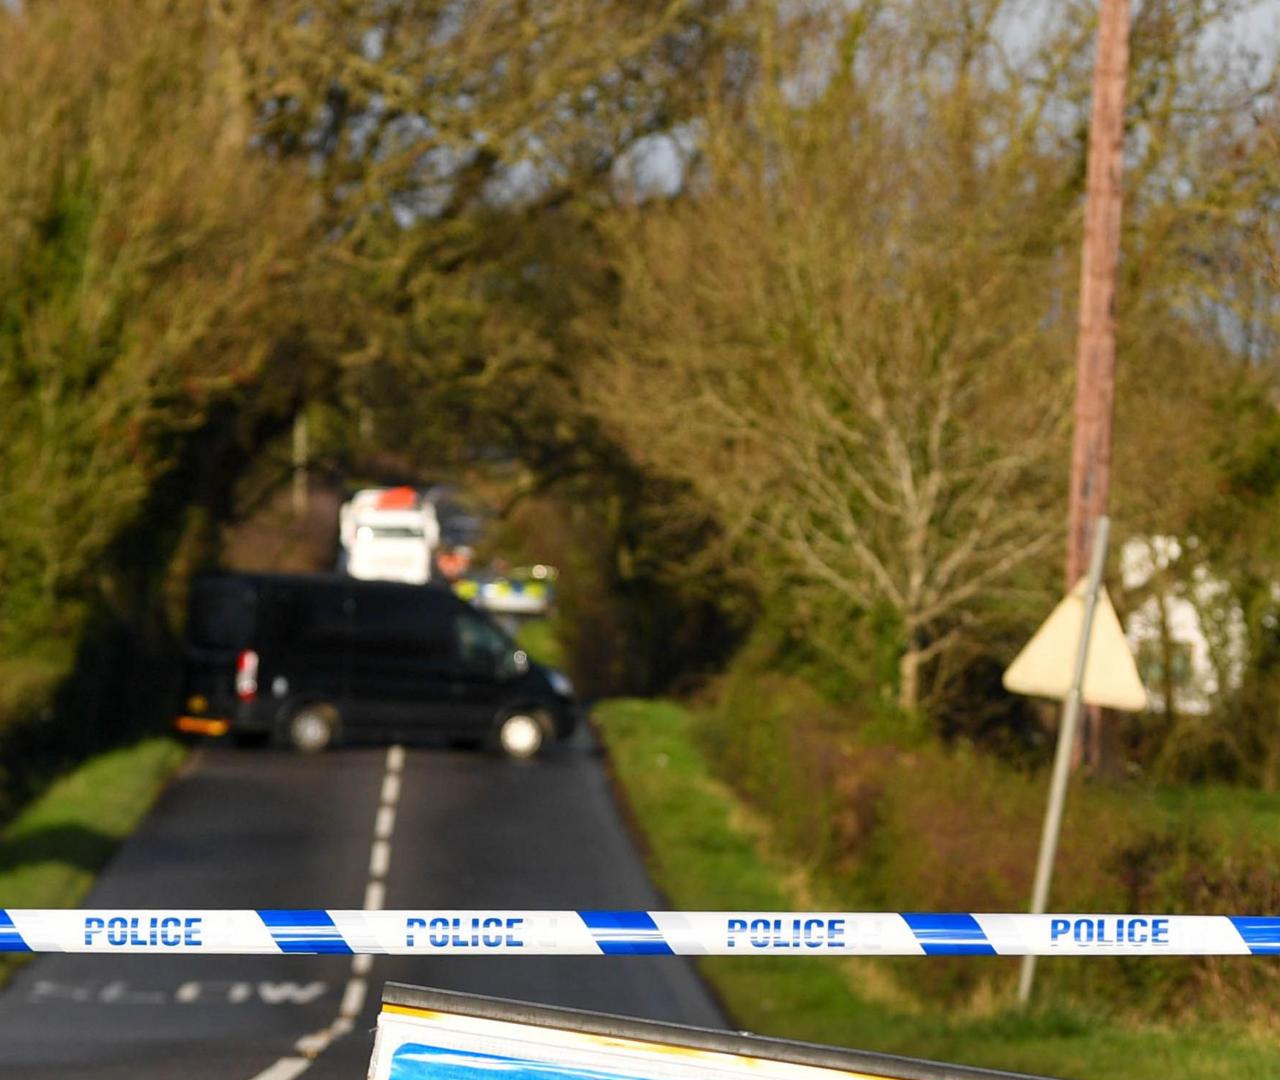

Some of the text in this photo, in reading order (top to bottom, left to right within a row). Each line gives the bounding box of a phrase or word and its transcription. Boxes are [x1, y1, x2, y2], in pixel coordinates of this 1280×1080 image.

[84, 917, 202, 947] POLICE
[406, 917, 524, 947] POLICE
[726, 918, 845, 948] POLICE
[1050, 918, 1169, 946] POLICE
